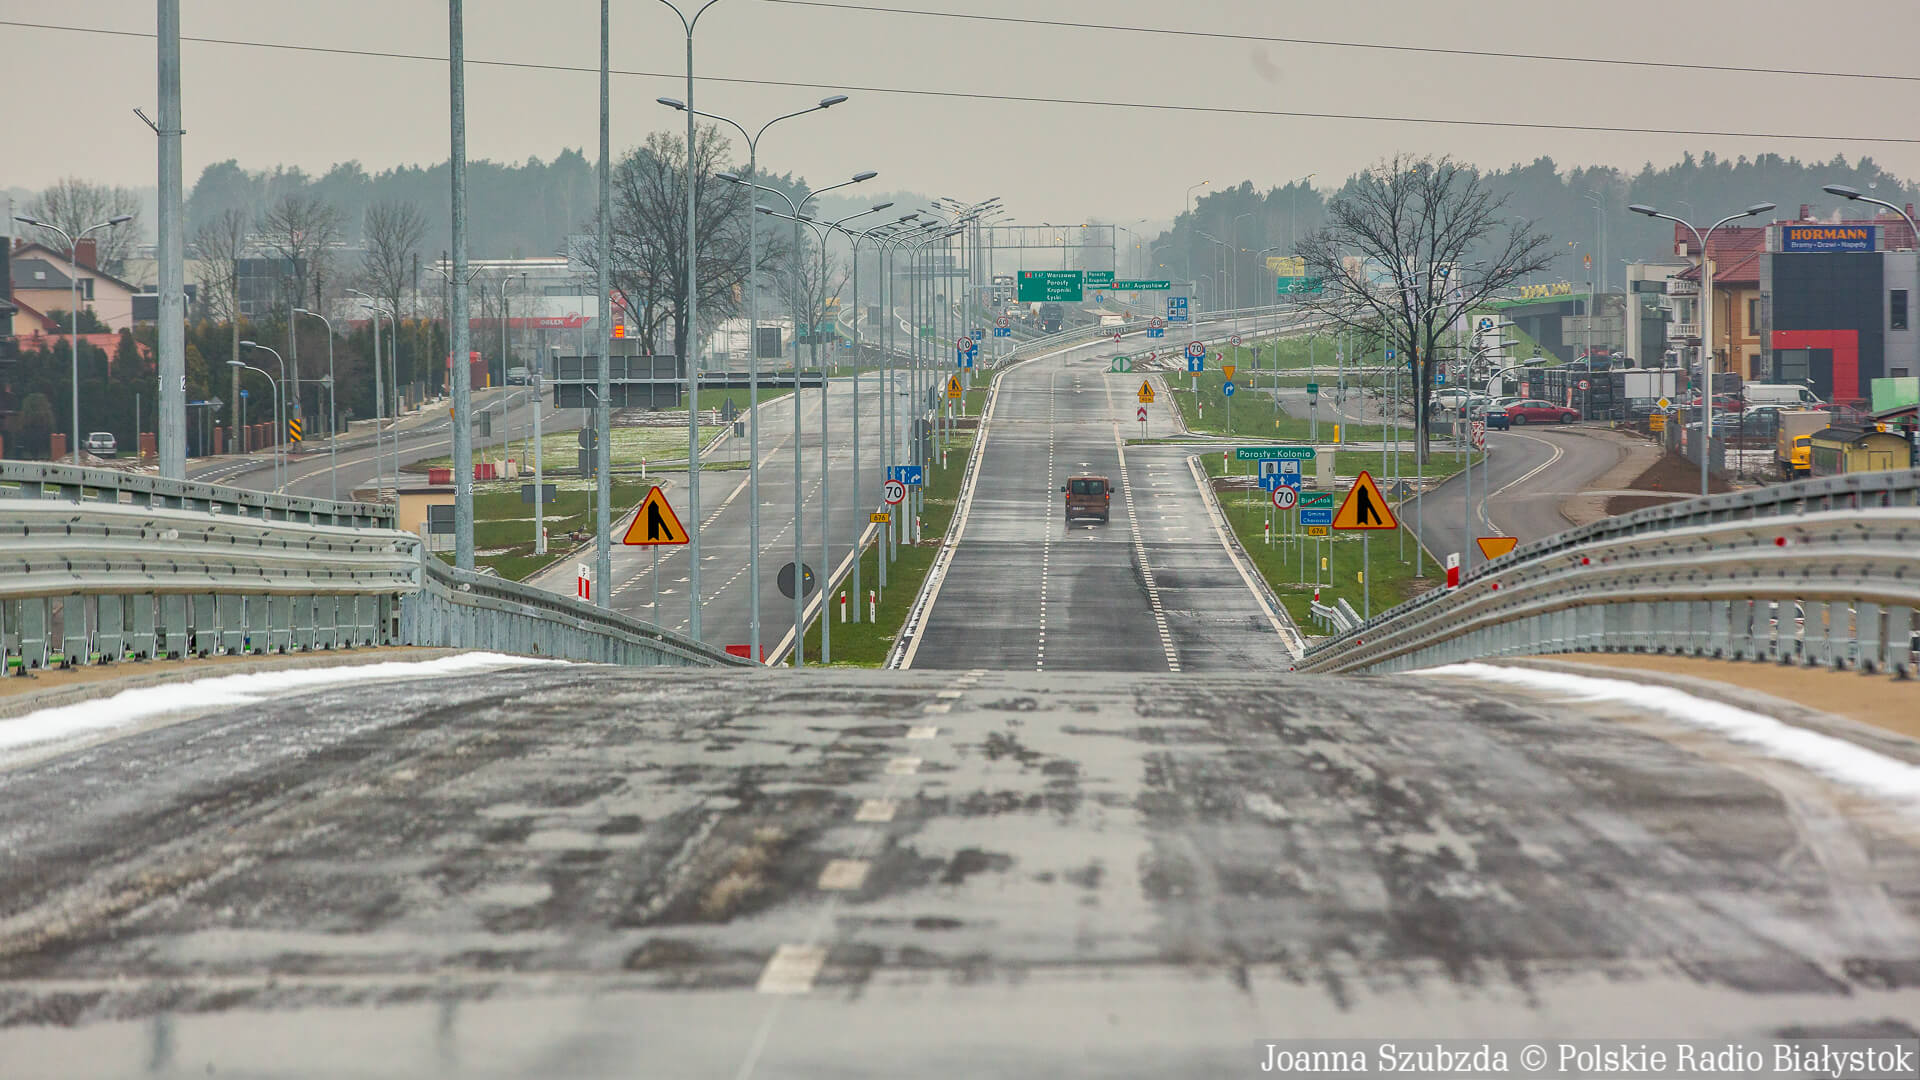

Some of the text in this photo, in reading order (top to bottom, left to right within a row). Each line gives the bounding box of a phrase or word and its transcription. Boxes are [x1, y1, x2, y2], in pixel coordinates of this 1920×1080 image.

[1152, 318, 1161, 326] 60
[1192, 344, 1202, 353] 70
[885, 486, 902, 499] 70
[1276, 491, 1294, 504] 70
[1311, 527, 1324, 535] 676
